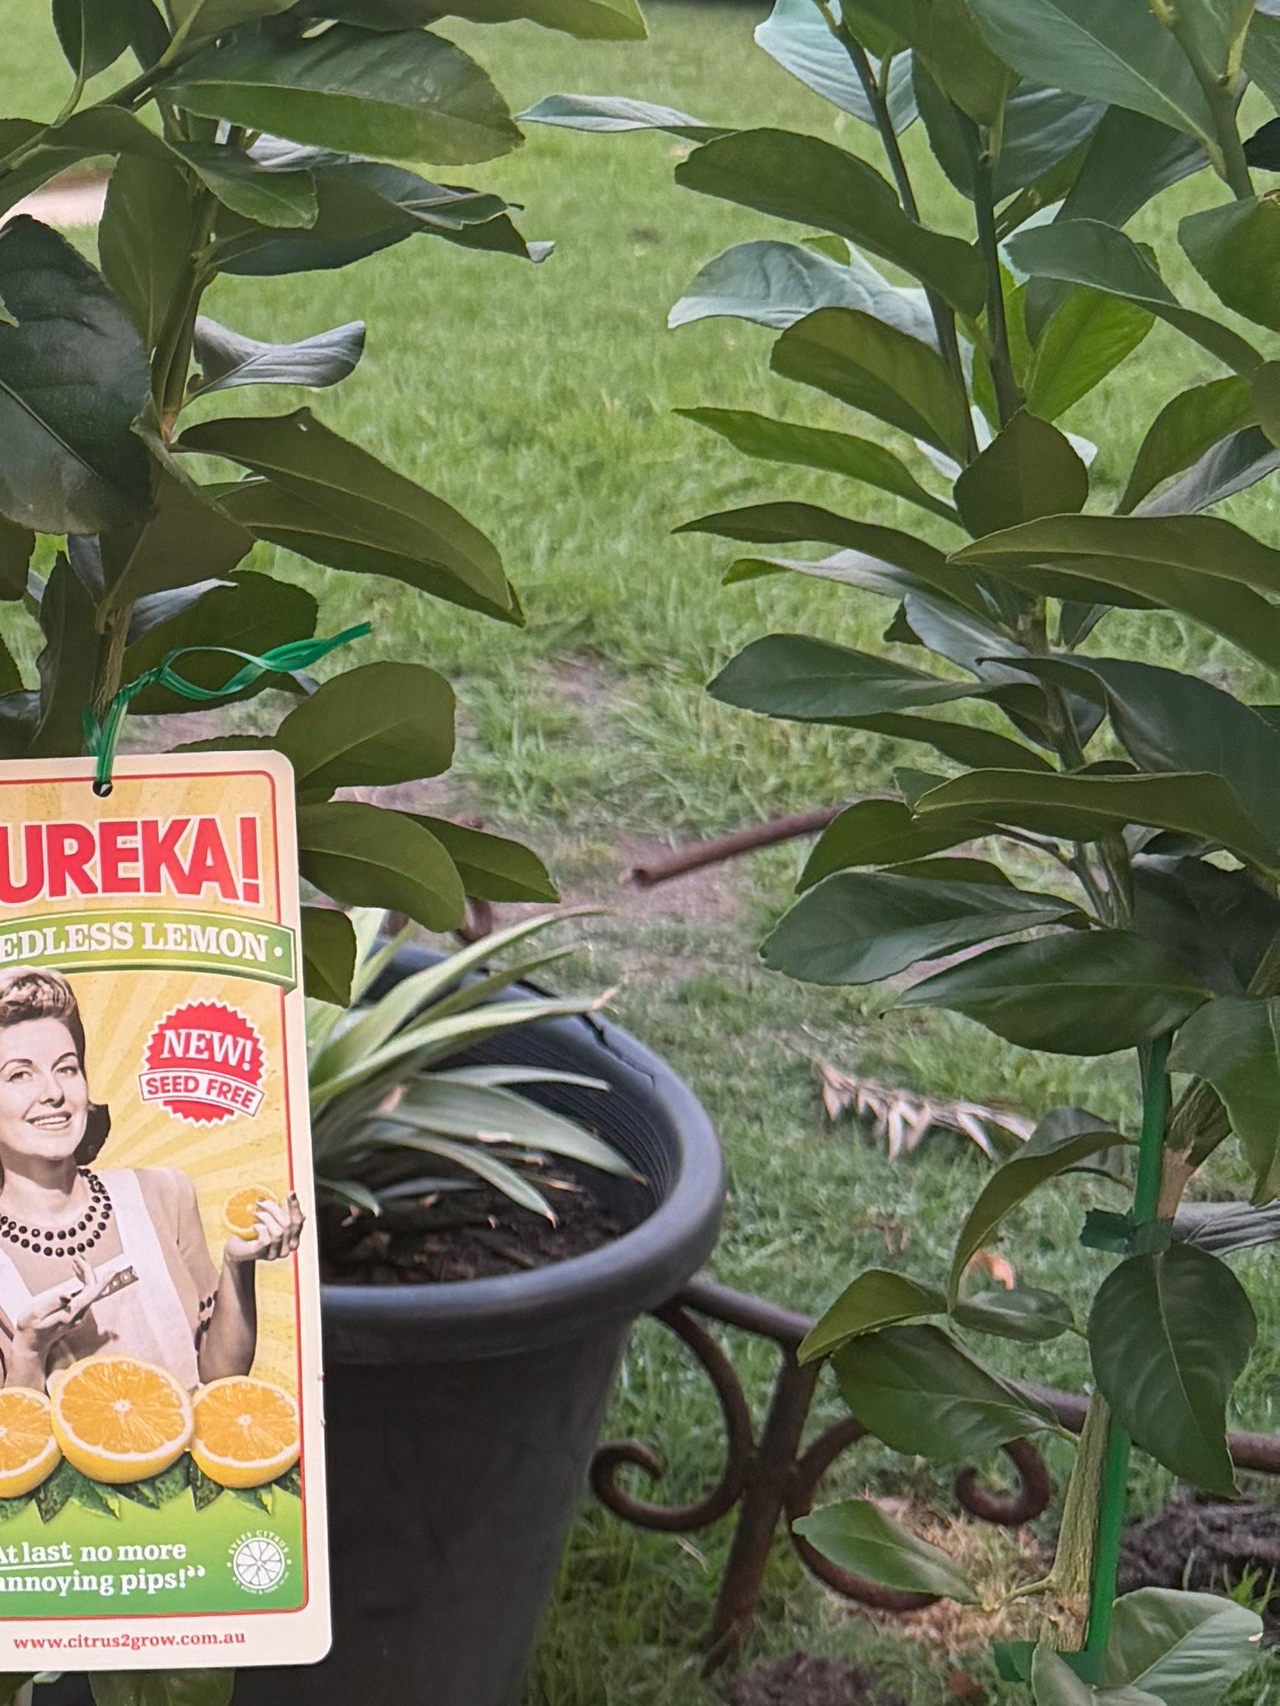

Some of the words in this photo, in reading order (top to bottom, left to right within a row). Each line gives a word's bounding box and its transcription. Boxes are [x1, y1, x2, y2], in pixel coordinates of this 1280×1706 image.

[141, 922, 269, 963] LEMON
[159, 1028, 253, 1072] NEW!
[145, 1075, 200, 1096] SEED
[205, 1078, 257, 1110] FREE
[20, 1541, 73, 1563] last
[80, 1545, 113, 1563] no
[117, 1542, 188, 1561] more
[12, 1631, 246, 1651] www.citrus2grow.com.au
